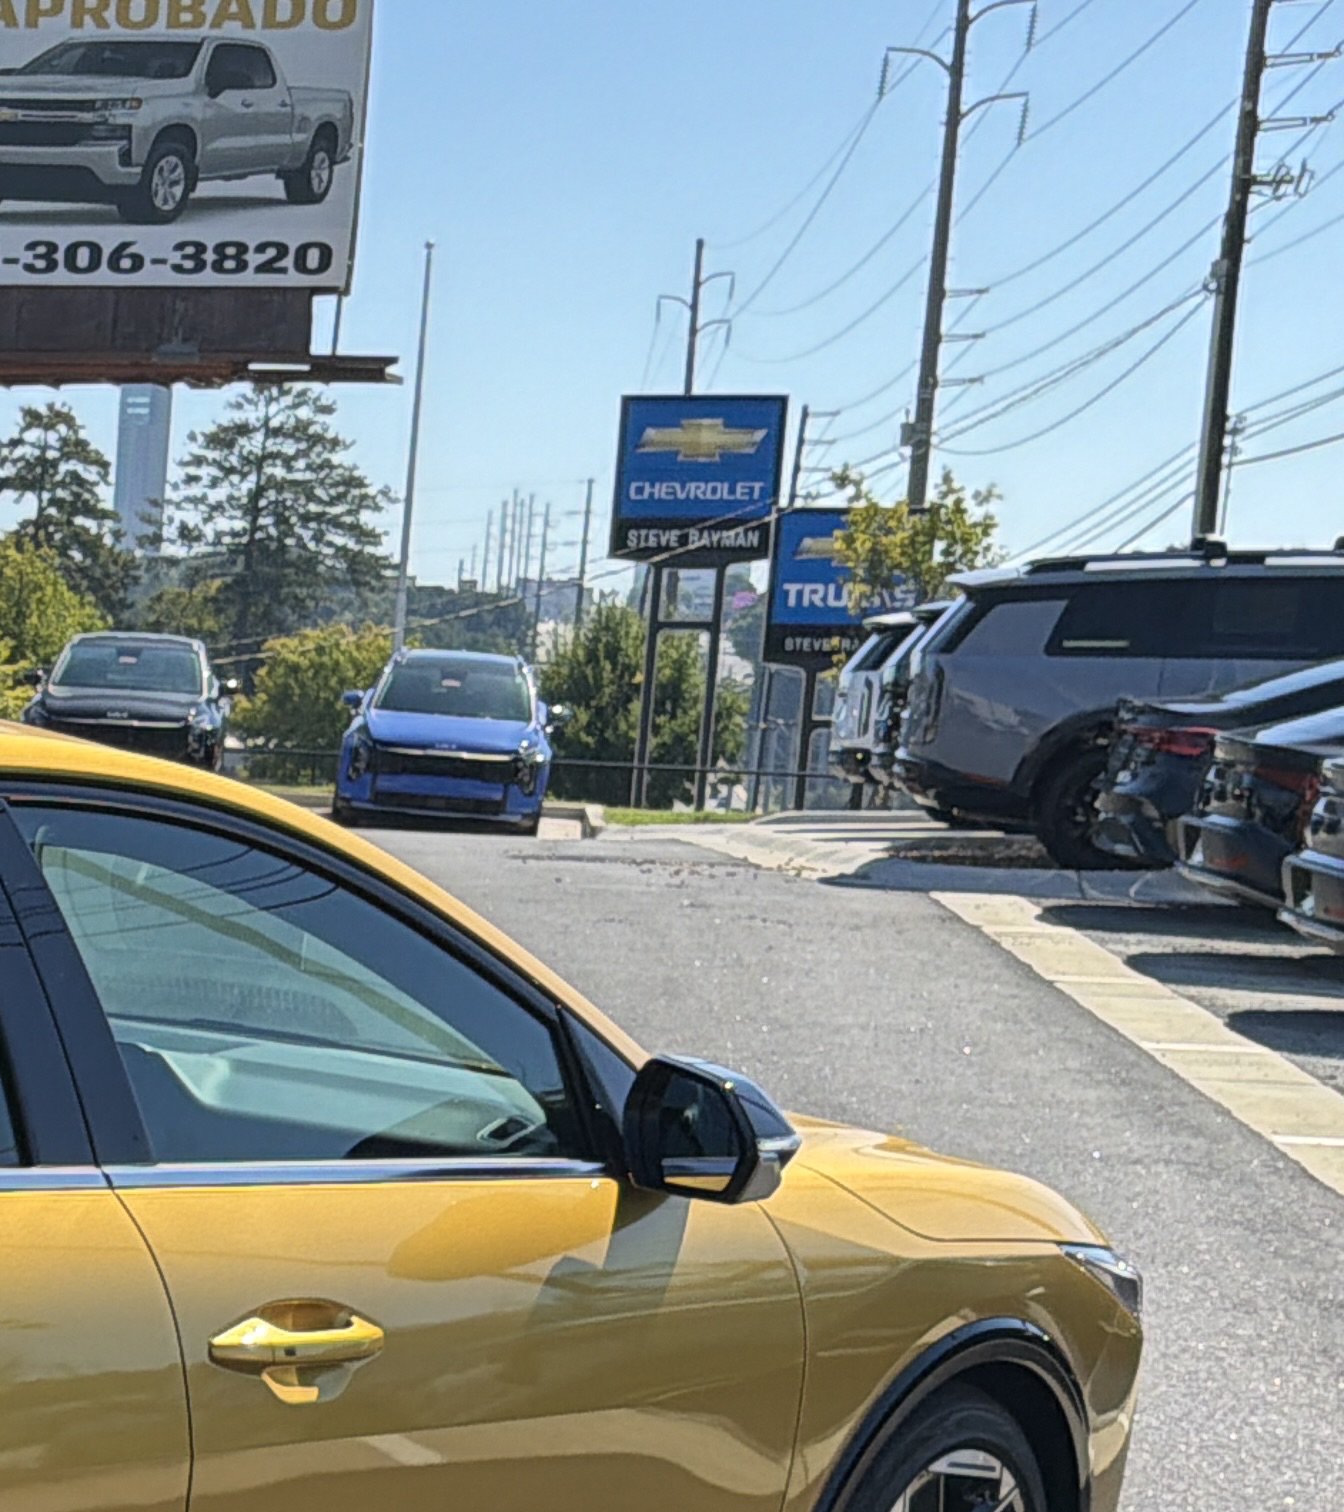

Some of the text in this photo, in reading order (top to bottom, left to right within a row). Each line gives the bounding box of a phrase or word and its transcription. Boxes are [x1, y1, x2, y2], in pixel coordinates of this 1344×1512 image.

[628, 480, 765, 501] CHEVROLET
[626, 528, 681, 549] STEVE
[782, 582, 917, 609] TRUS
